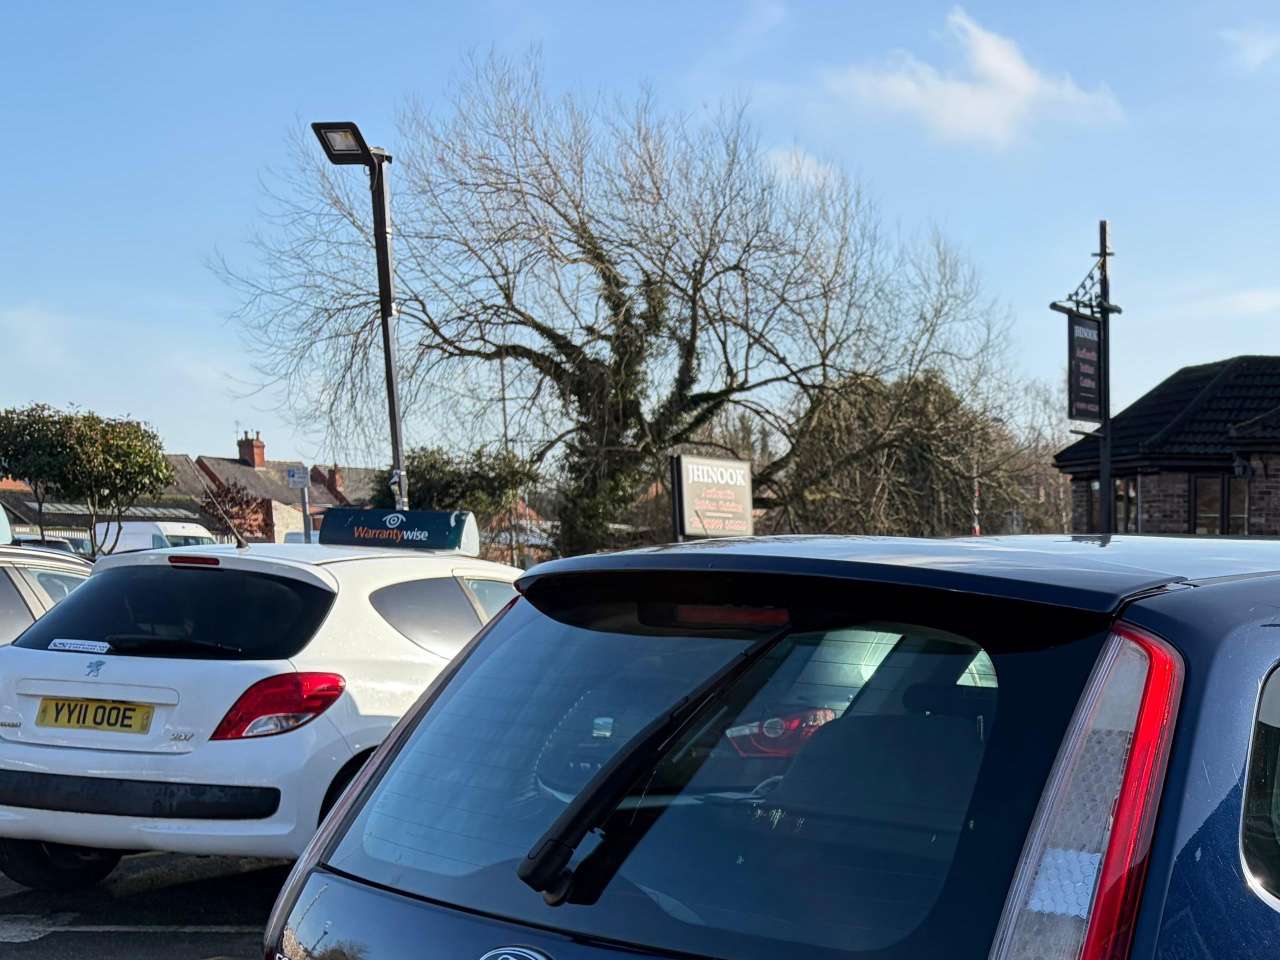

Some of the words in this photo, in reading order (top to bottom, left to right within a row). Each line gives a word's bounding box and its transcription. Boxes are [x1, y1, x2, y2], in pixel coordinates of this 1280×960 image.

[688, 464, 746, 486] JHINOOK
[354, 526, 429, 543] Warrantywise
[54, 702, 88, 725] YY11
